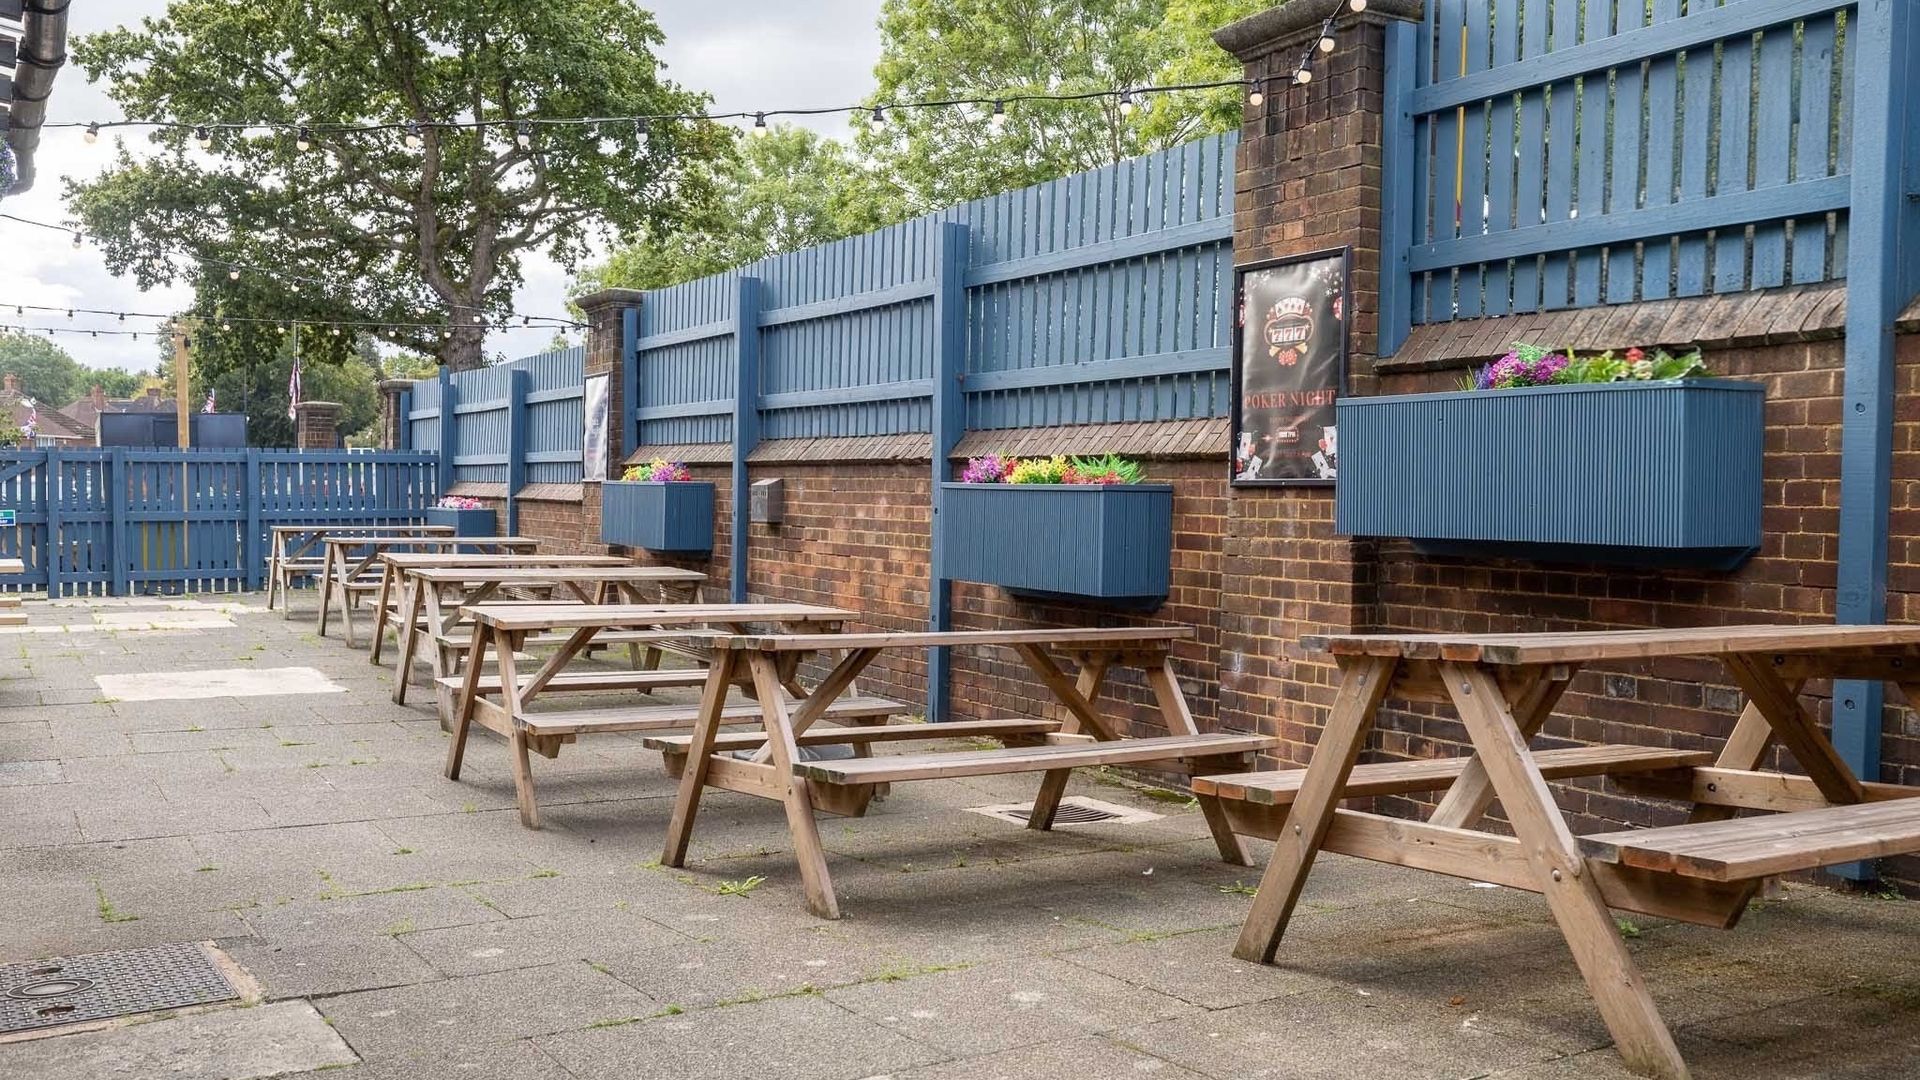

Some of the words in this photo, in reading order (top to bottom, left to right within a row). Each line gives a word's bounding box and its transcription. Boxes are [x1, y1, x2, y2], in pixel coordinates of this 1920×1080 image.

[1273, 328, 1304, 341] 777
[1244, 393, 1286, 409] POKER
[1291, 389, 1336, 406] NIGHT
